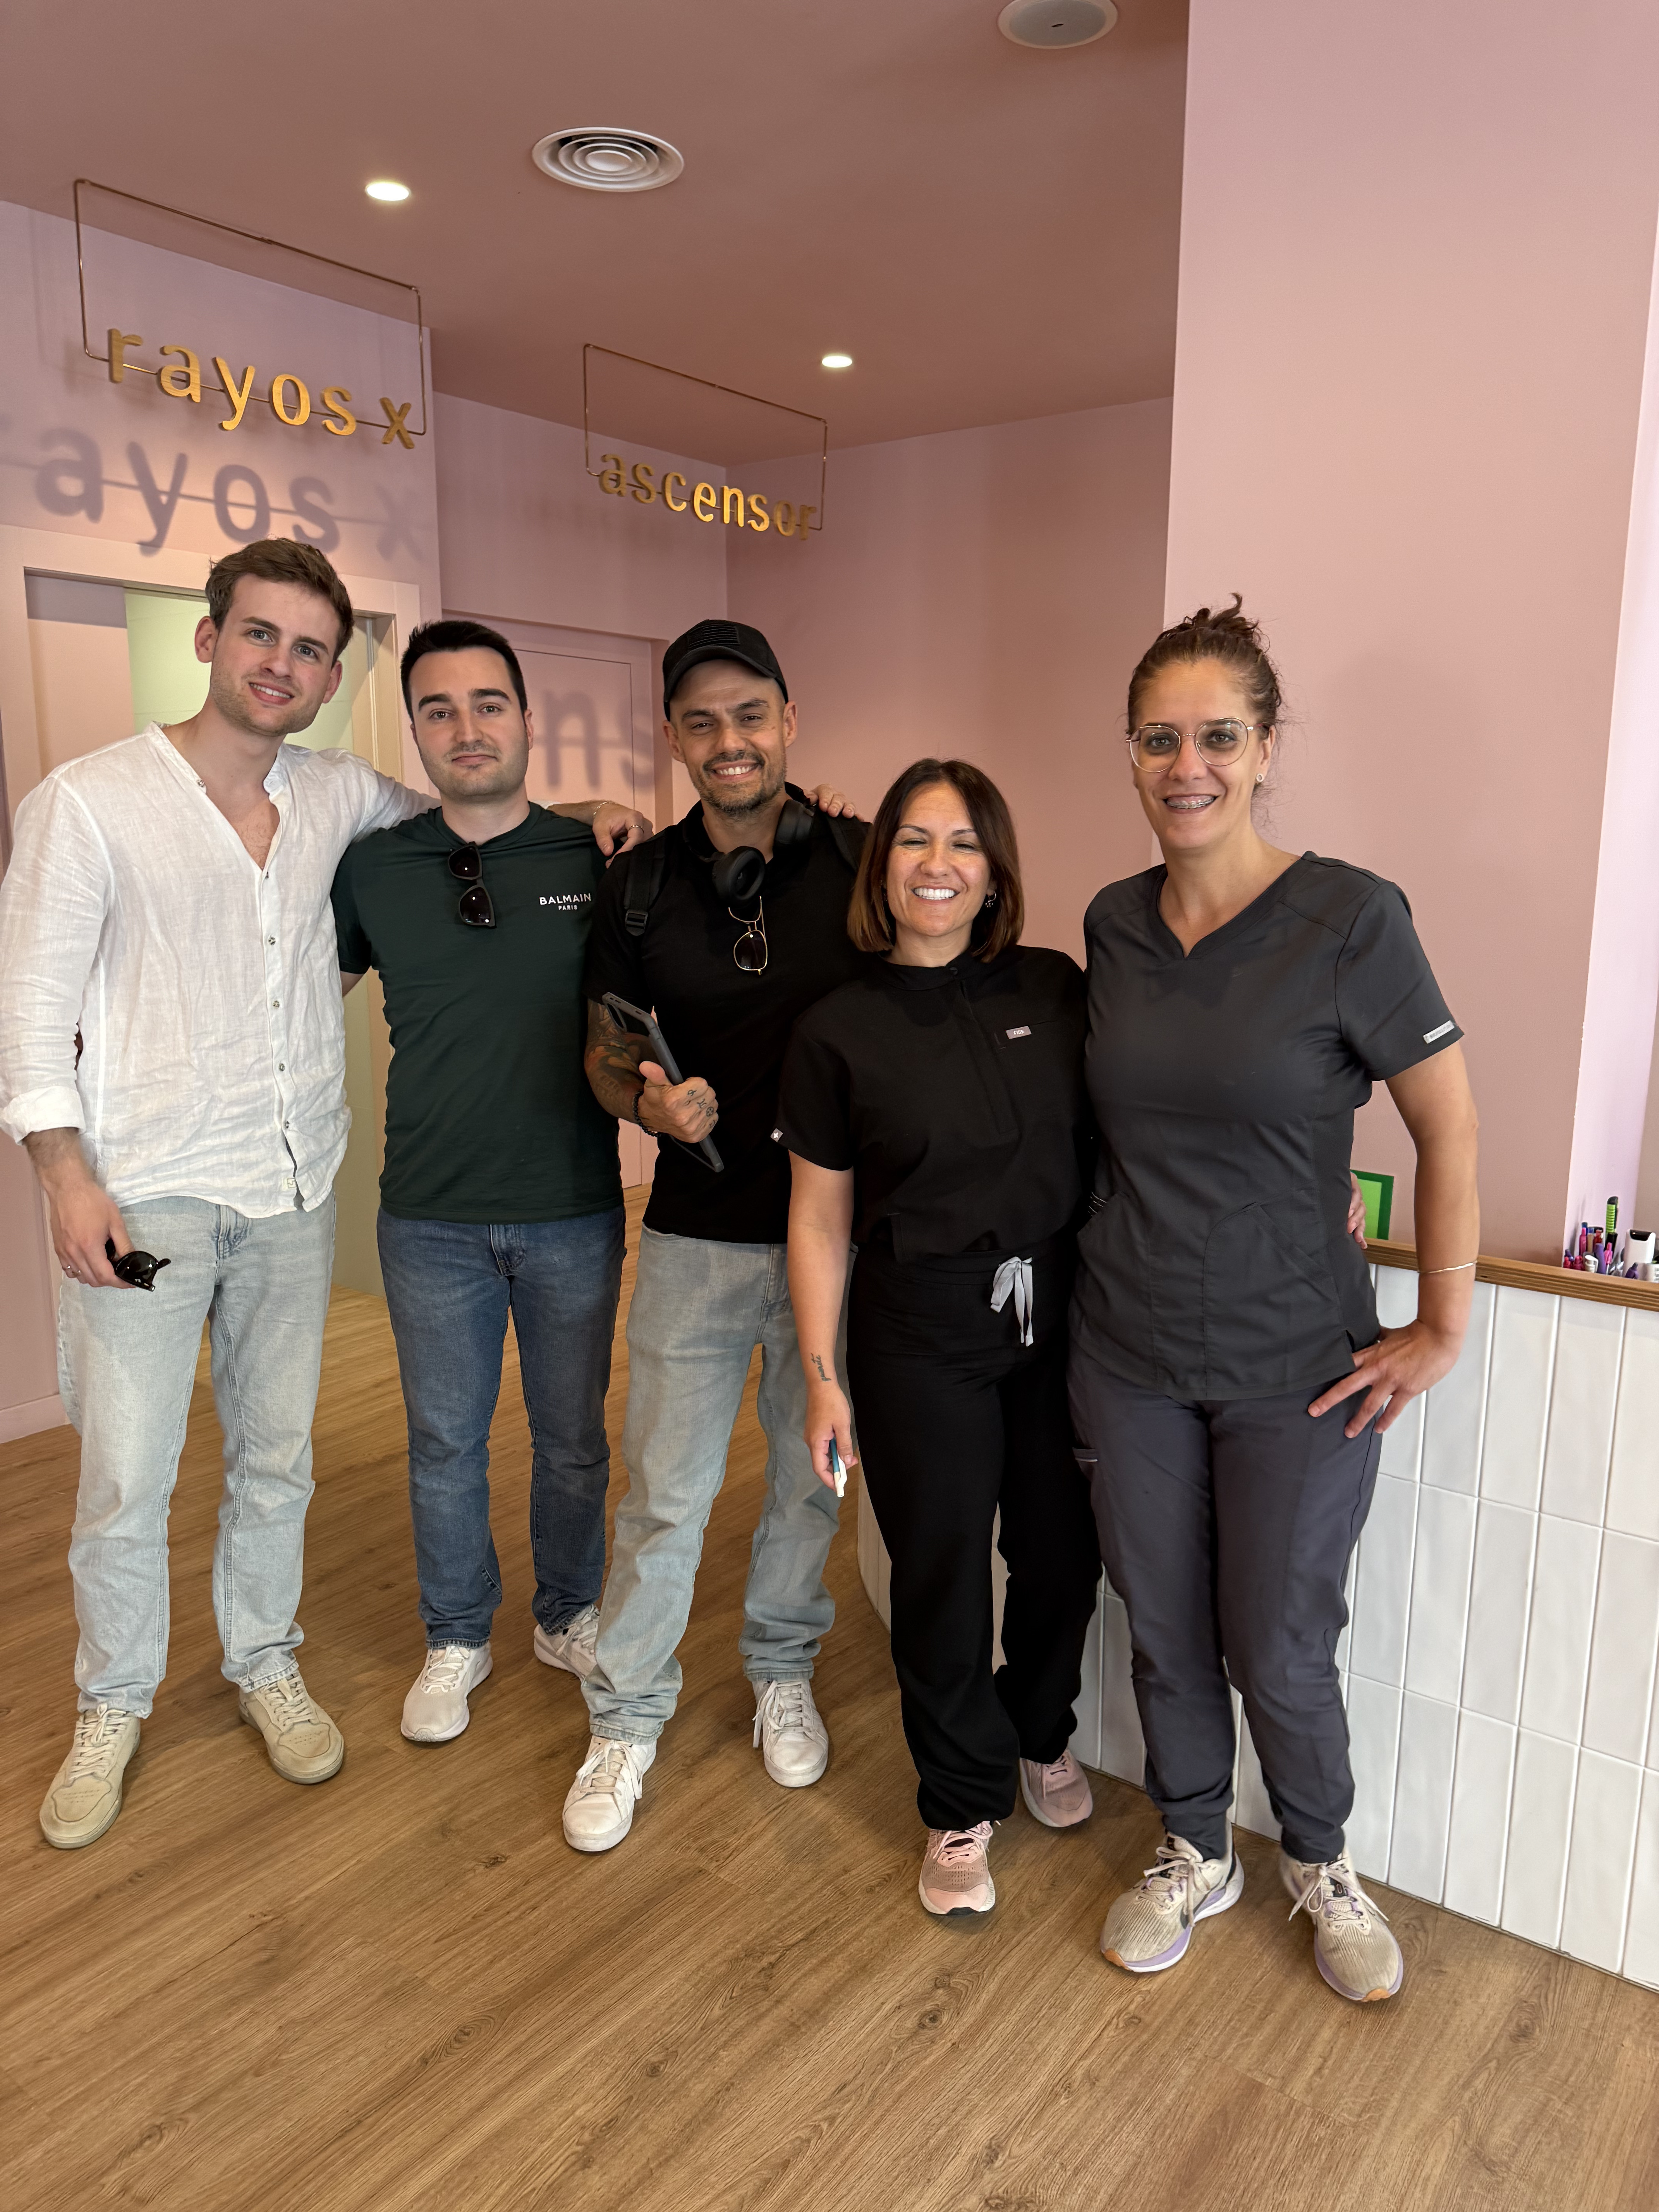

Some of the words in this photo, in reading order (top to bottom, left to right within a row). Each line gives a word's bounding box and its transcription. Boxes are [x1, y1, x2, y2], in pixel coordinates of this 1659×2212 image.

[108, 328, 357, 436] rayos
[380, 397, 415, 449] x
[600, 454, 817, 540] ascensor
[539, 893, 591, 905] BALMAIN
